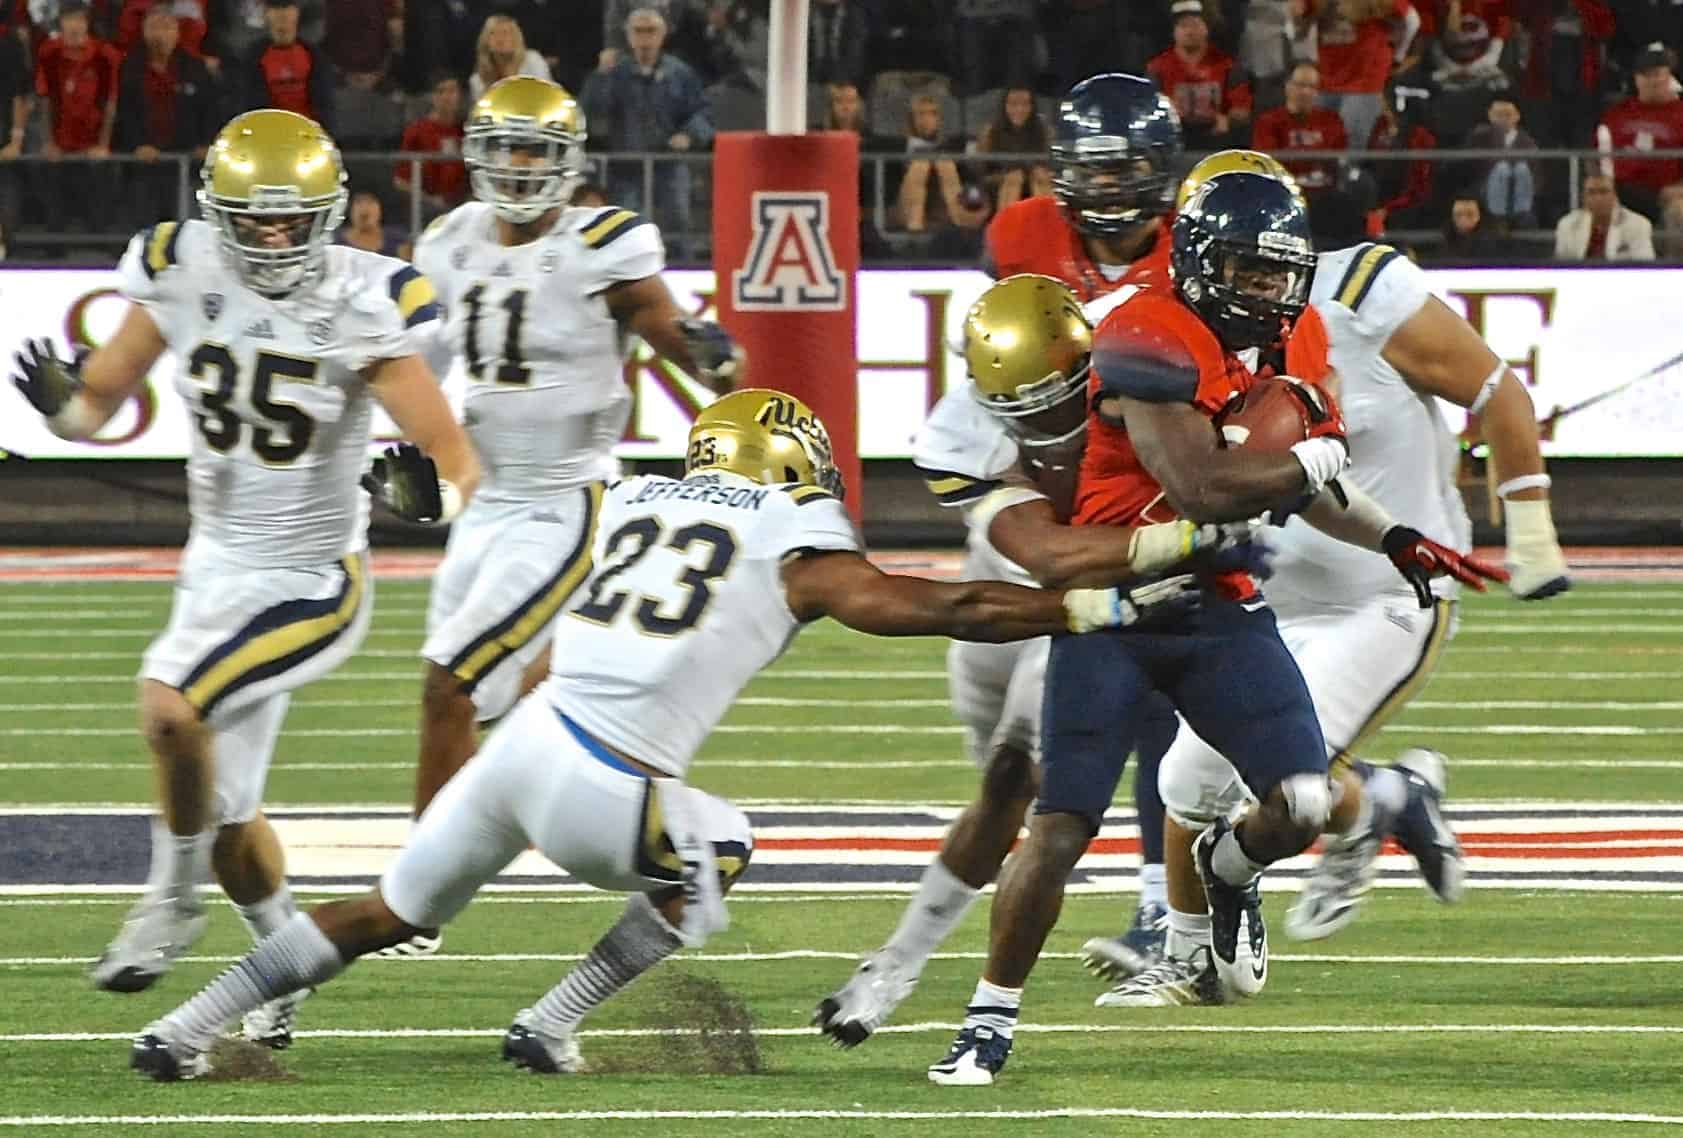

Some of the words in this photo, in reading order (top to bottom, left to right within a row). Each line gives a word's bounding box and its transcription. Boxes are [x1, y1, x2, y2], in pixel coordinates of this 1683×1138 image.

[732, 191, 847, 313] A
[461, 285, 533, 386] 11
[188, 336, 320, 467] 35
[625, 480, 769, 511] JEFFERSON
[566, 513, 738, 639] 23
